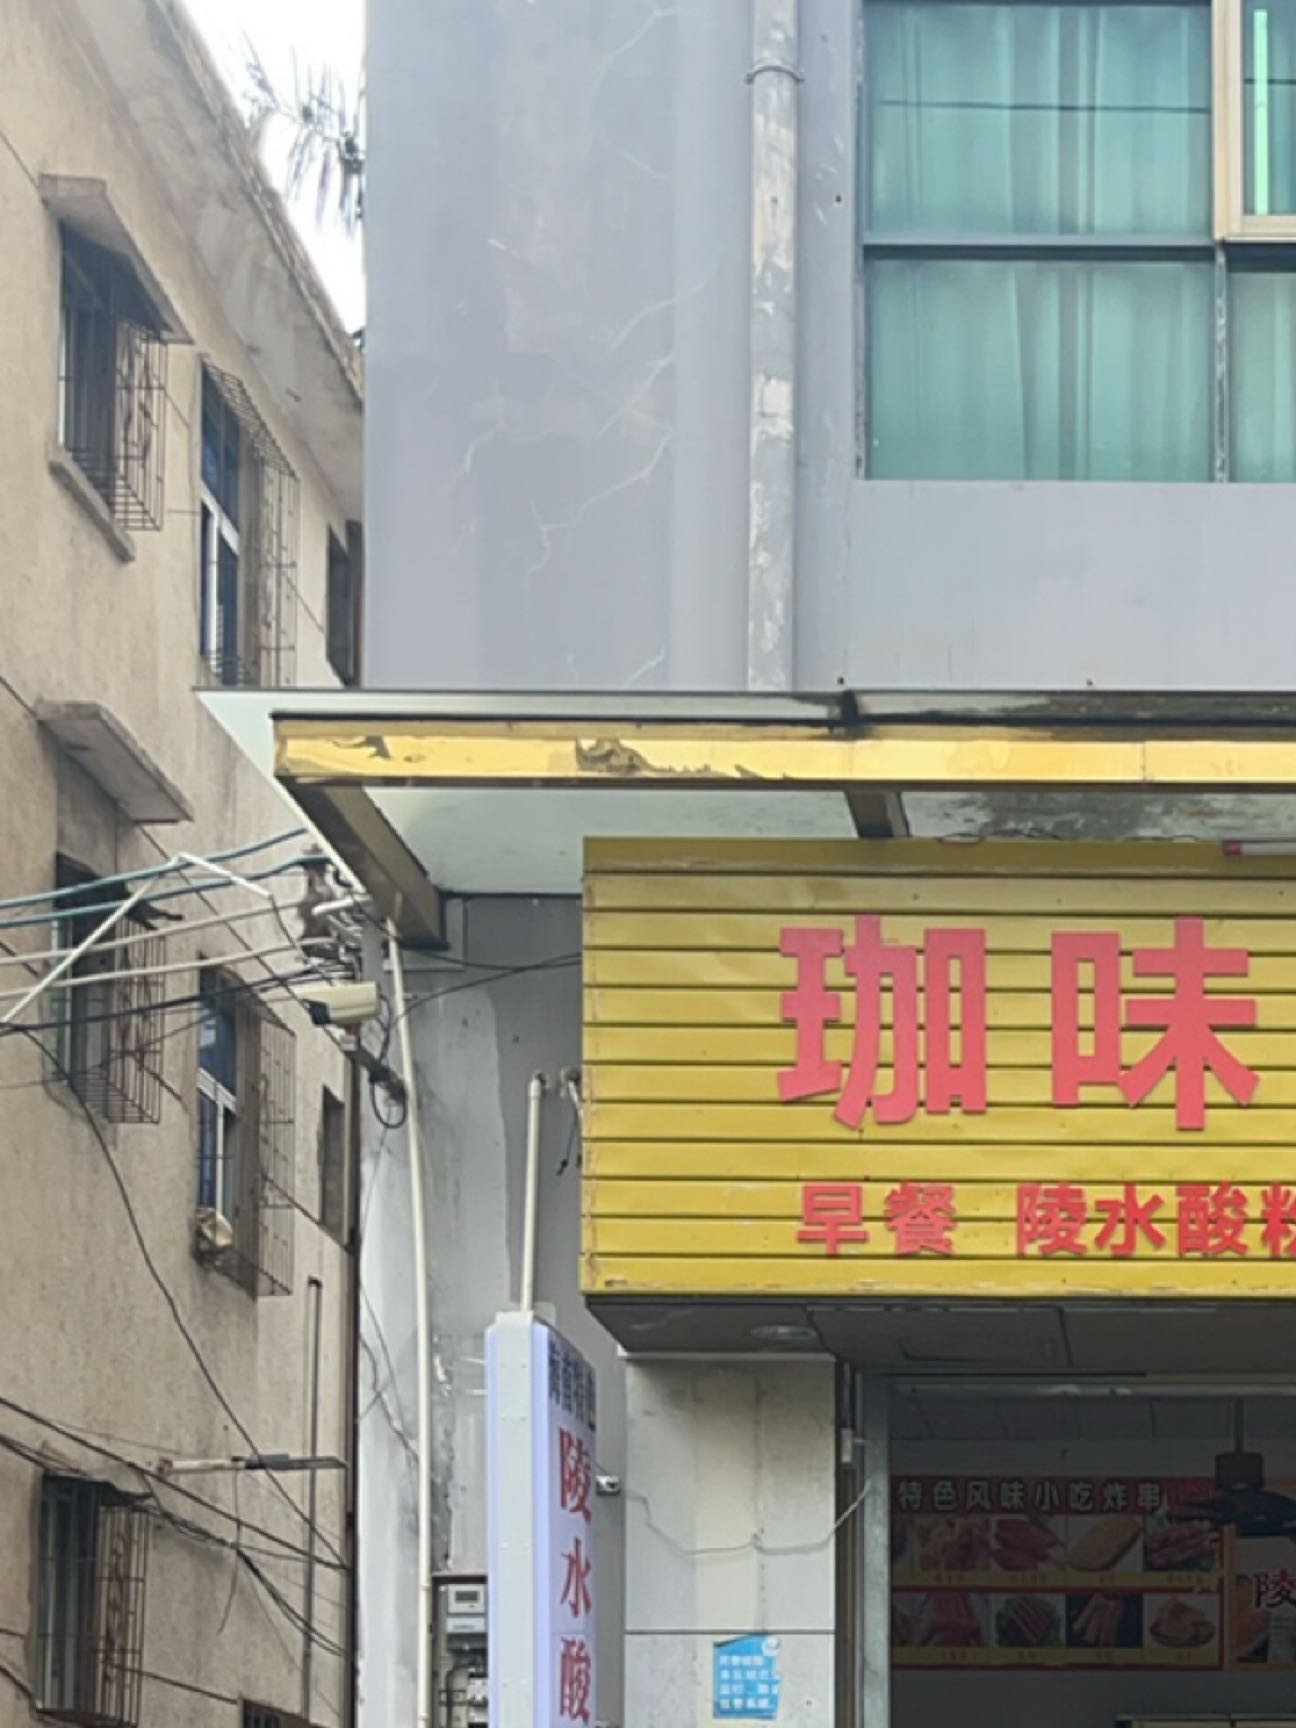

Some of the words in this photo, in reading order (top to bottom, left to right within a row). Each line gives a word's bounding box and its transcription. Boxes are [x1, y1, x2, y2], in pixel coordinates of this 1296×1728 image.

[796, 1181, 957, 1258] 早餐
[899, 1480, 1164, 1512] 特色风味小吃炸串
